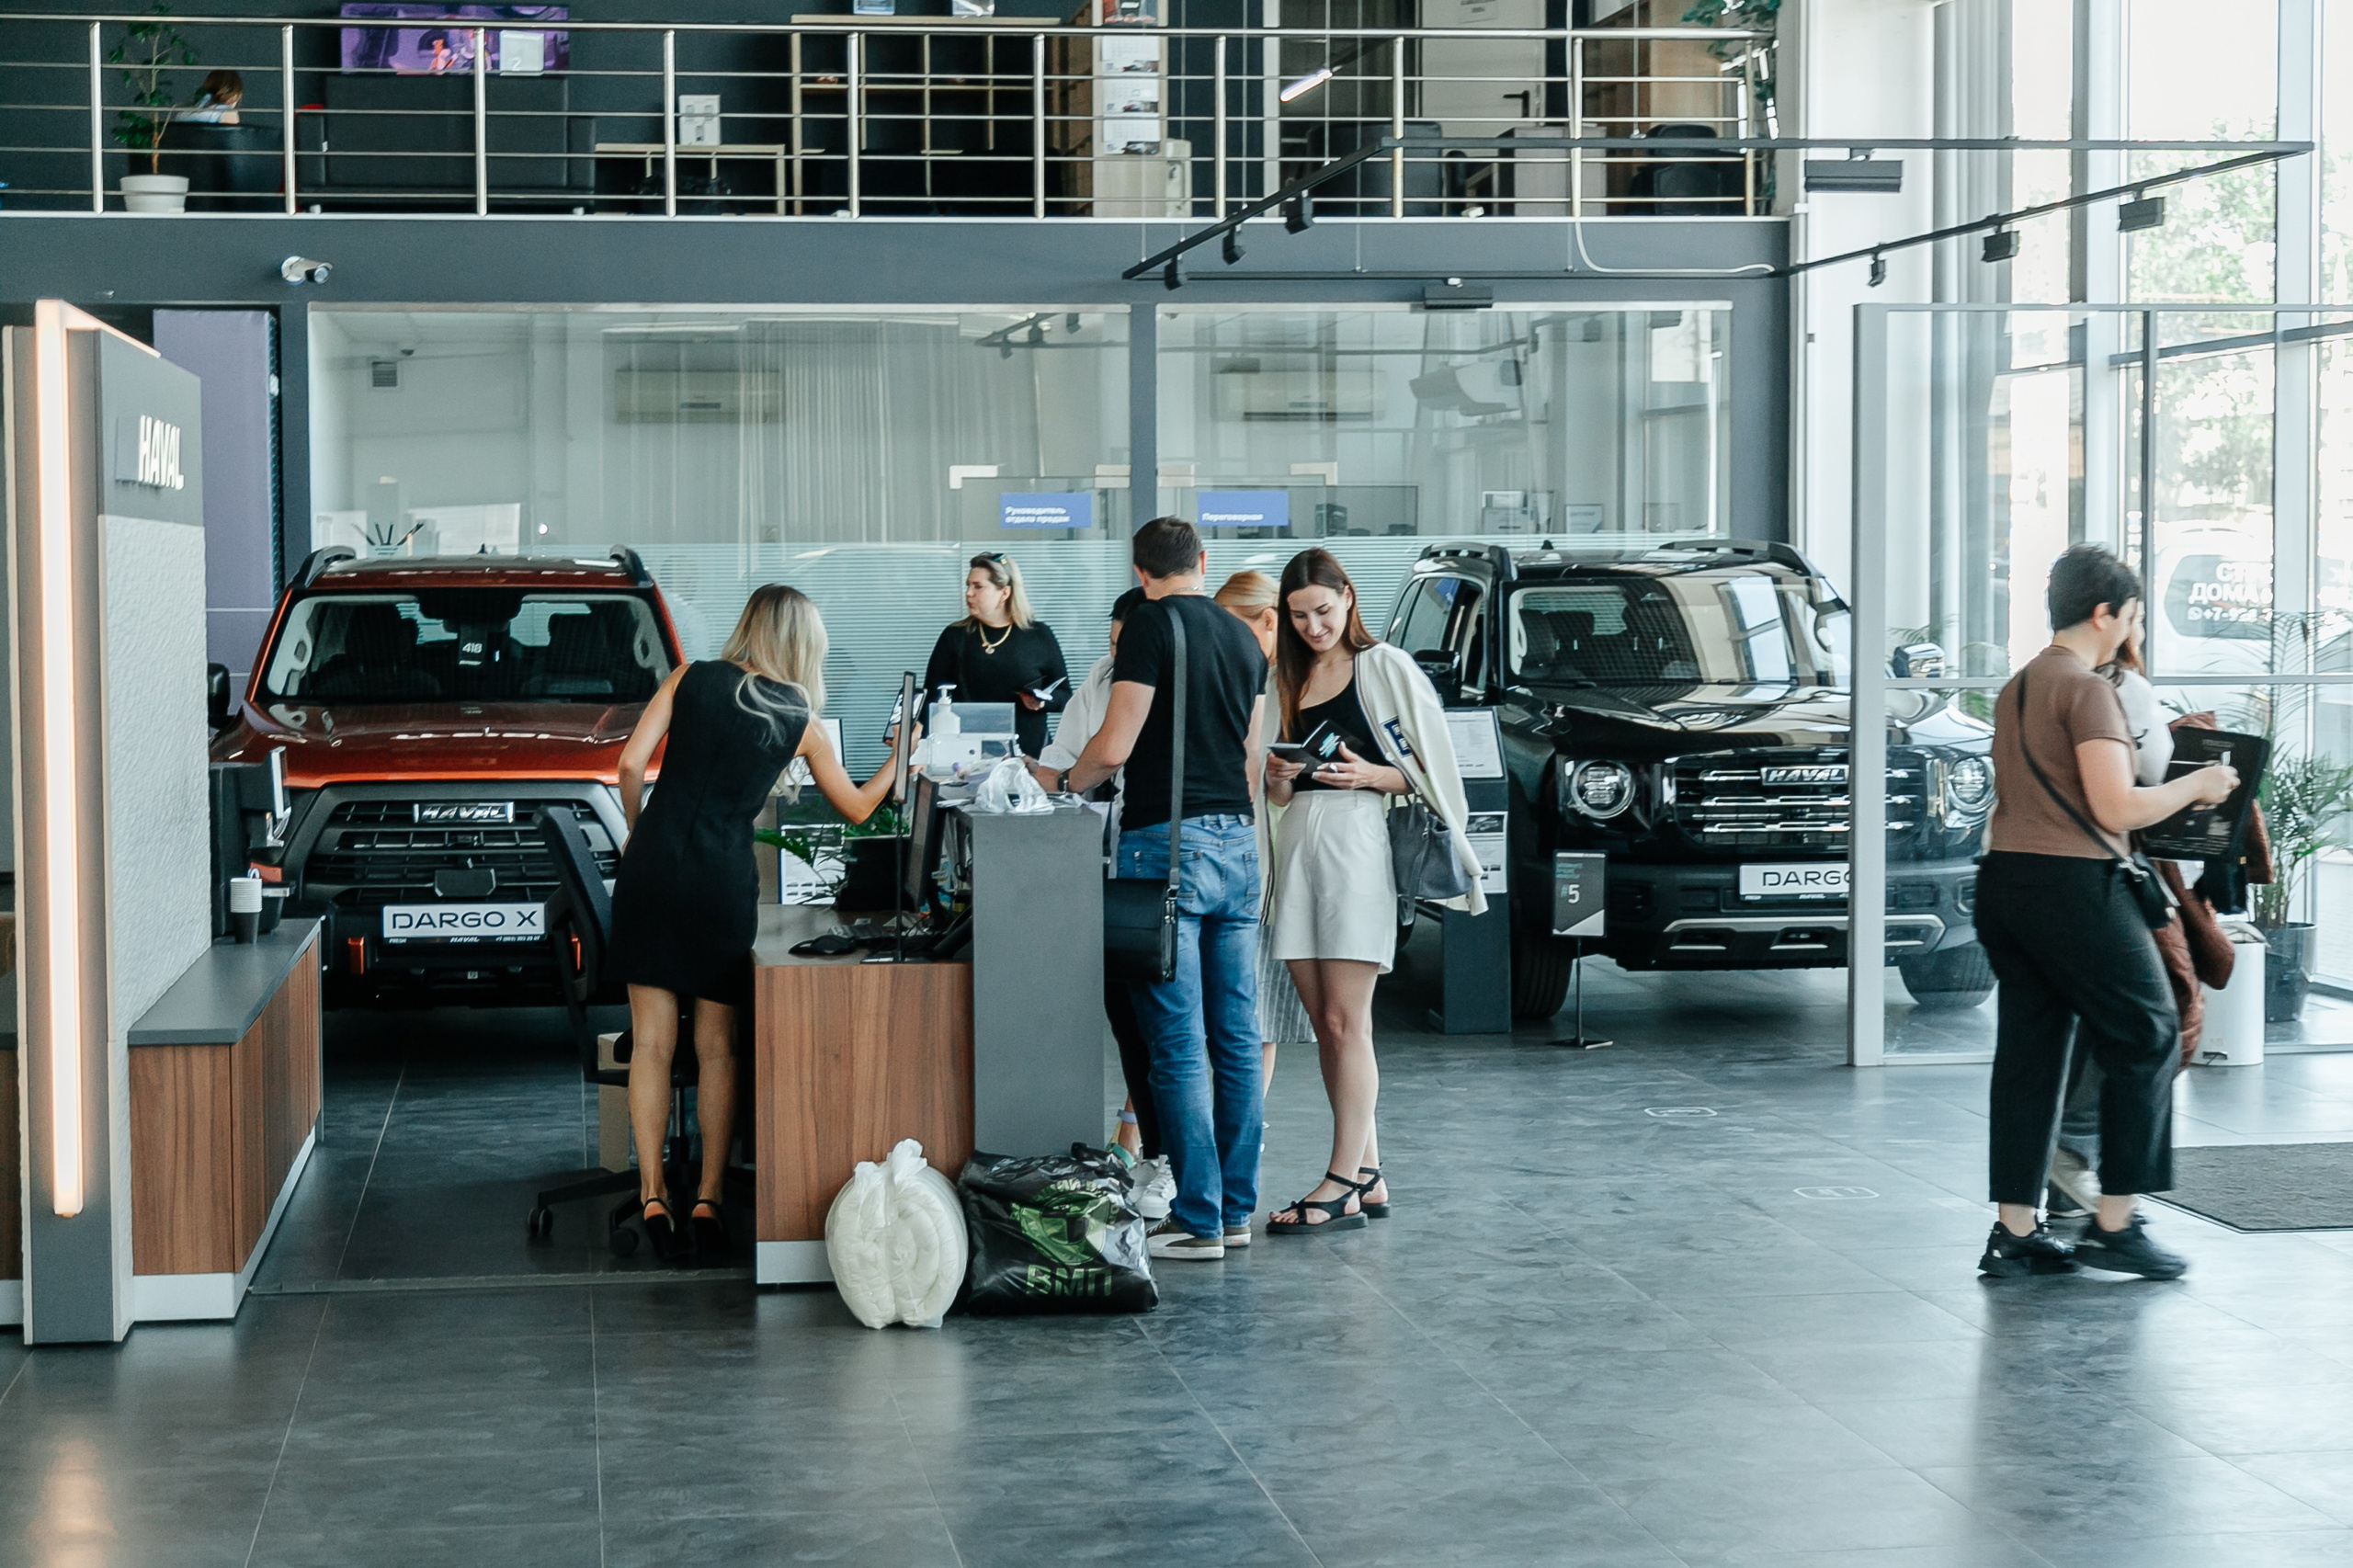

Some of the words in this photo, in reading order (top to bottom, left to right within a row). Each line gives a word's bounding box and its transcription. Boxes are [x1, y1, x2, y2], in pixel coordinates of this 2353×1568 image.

[138, 415, 185, 490] HAVAL
[1005, 506, 1067, 516] Руководитель
[1201, 513, 1264, 522] Переговорная
[2188, 583, 2259, 605] ДОМА
[462, 642, 483, 653] 418
[1768, 768, 1845, 782] HAVAL
[422, 806, 507, 820] HAVAL
[392, 911, 506, 929] DARGO
[517, 910, 538, 927] X
[1026, 1265, 1112, 1296] ВМП
